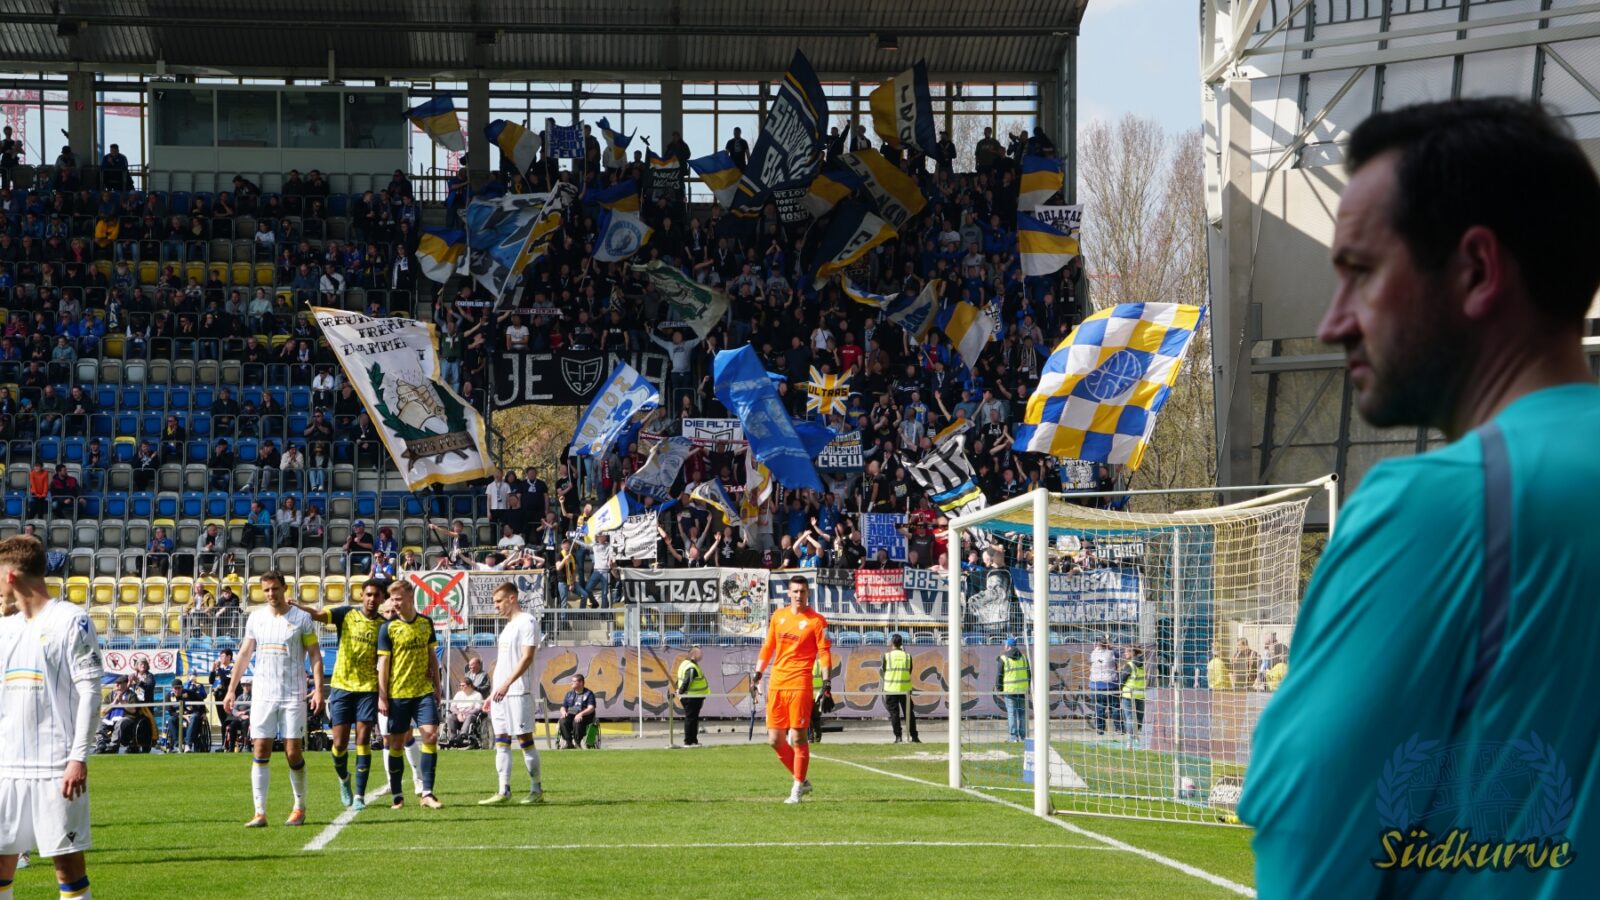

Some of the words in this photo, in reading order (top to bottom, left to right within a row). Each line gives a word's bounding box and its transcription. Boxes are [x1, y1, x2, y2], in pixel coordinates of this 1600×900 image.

[808, 386, 848, 397] ULTRAS
[684, 420, 704, 428] DIE
[706, 420, 740, 428] ALTE
[818, 455, 863, 467] CREW
[905, 568, 939, 589] 385
[625, 580, 718, 602] ULTRAS
